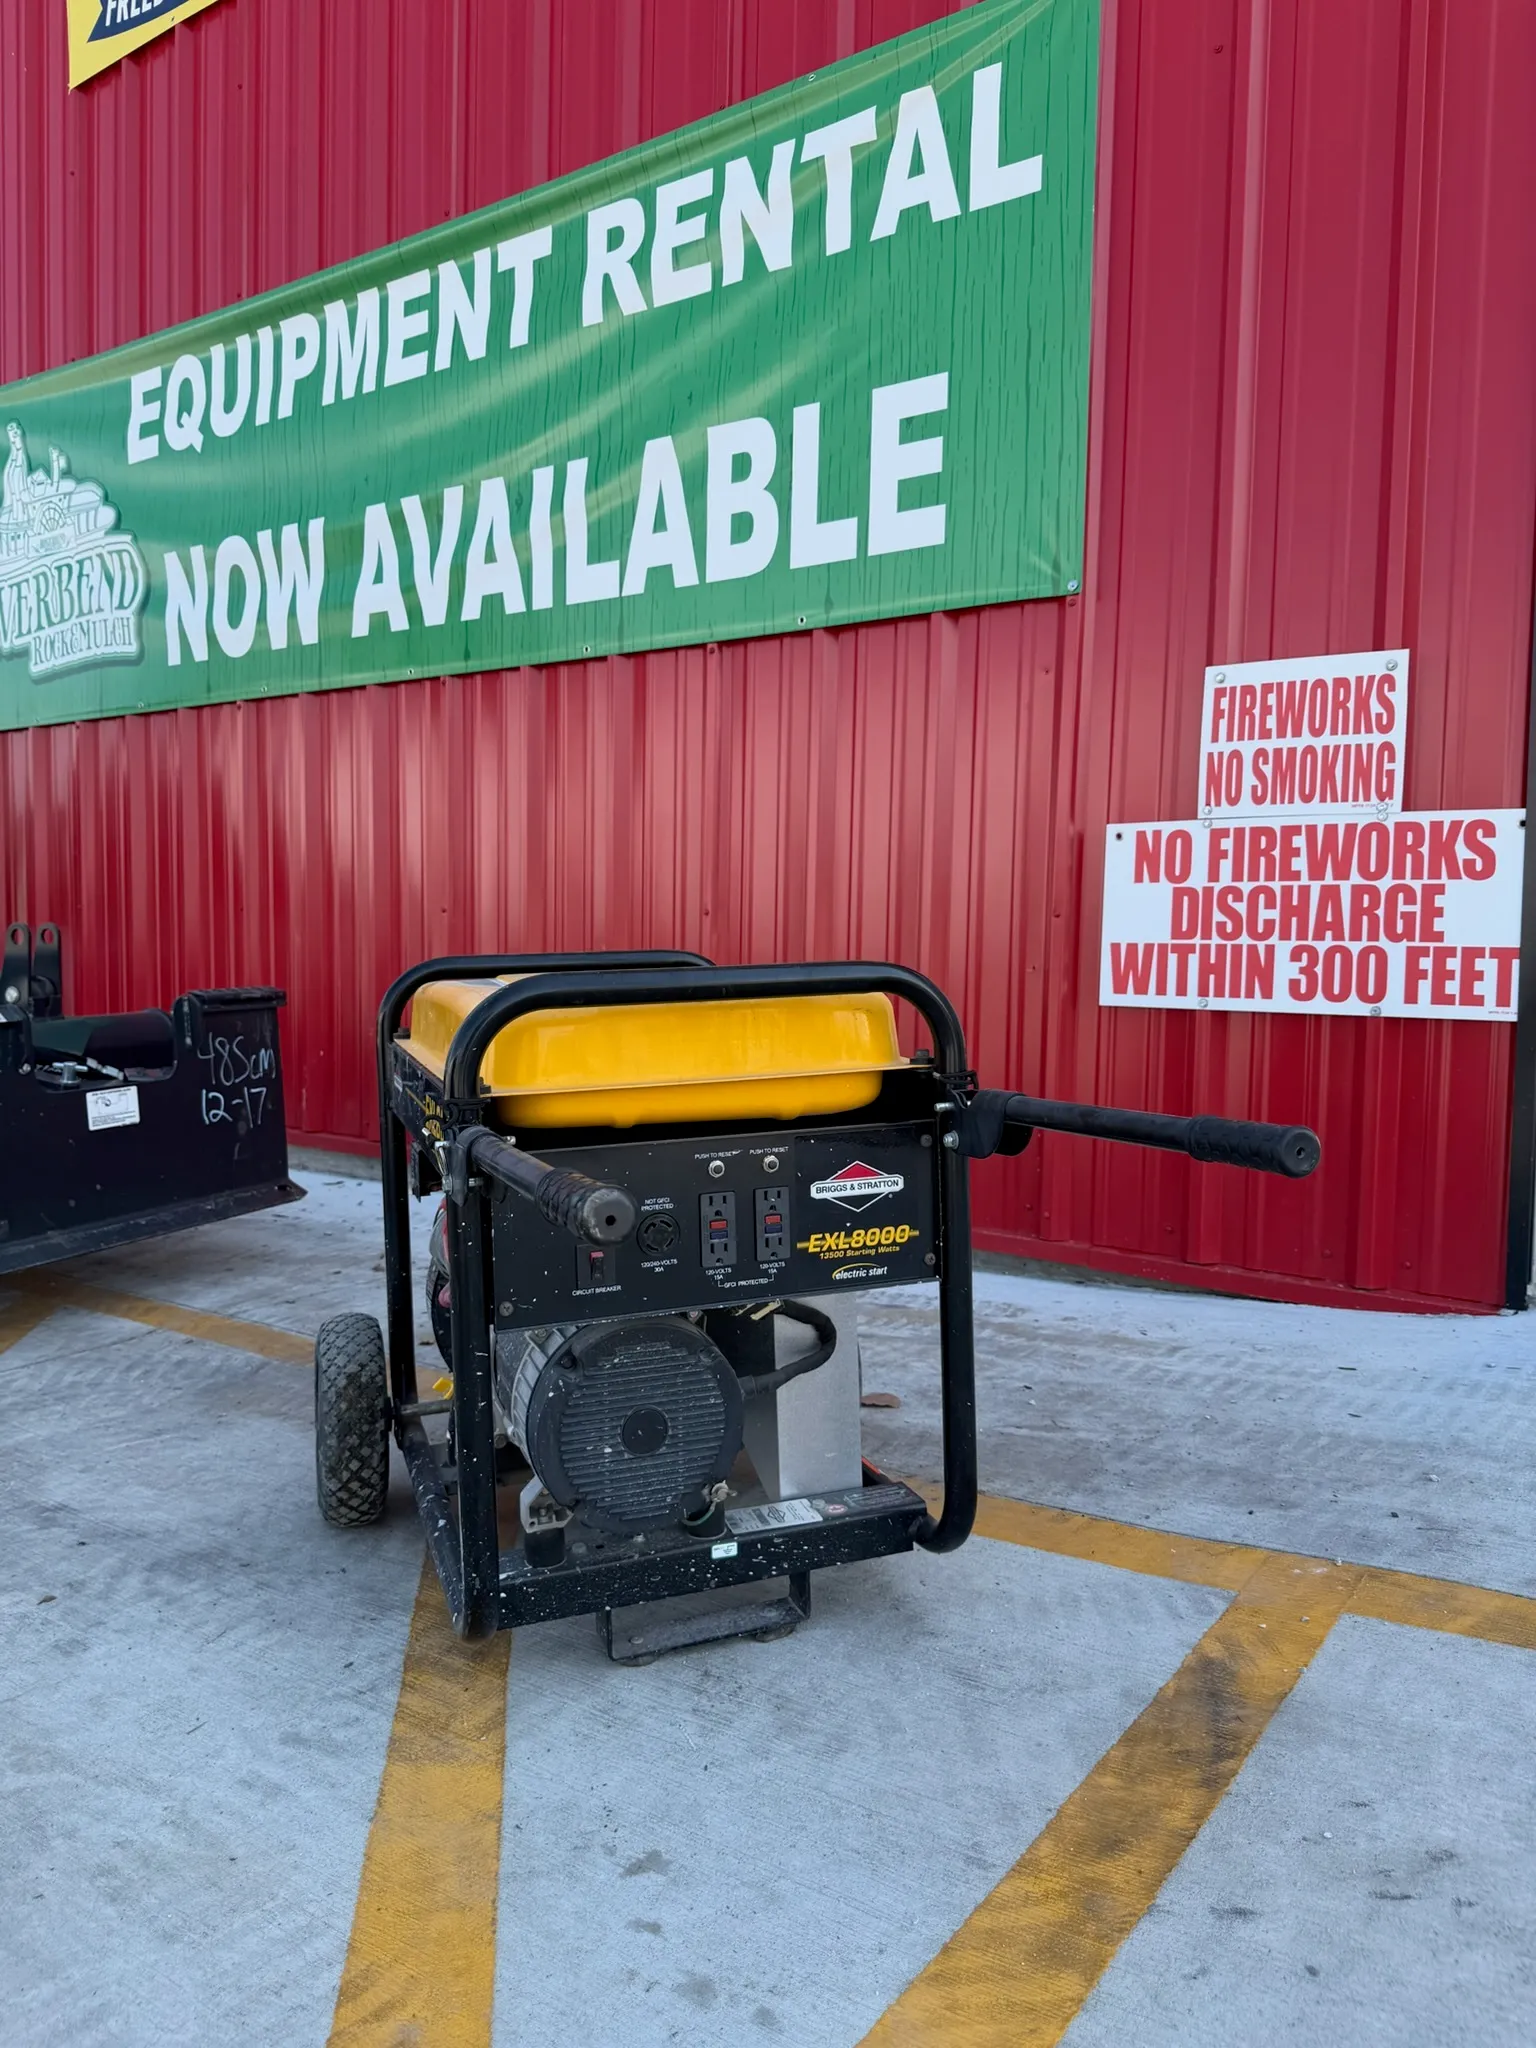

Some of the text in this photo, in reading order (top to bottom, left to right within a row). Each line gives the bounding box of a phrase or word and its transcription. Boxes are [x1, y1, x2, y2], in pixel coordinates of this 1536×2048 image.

[127, 62, 1042, 464] EQUIPMENT RENTAL
[164, 372, 948, 666] NOW AVAILABLE
[1211, 674, 1396, 743] FIREWORKS
[1206, 741, 1396, 807] NO SMOKING
[1134, 819, 1497, 884] NO FIREWORKS
[1170, 884, 1446, 943] DISCHARGE
[1110, 942, 1520, 1008] WITHIN 300 FEET
[202, 1086, 267, 1128] 12-17
[815, 1184, 847, 1194] BRIGGS
[857, 1179, 899, 1190] STRATTON
[641, 1203, 674, 1211] PROTECTED
[808, 1224, 910, 1253] EXL8000
[820, 1245, 900, 1260] 13500 Starting Watts
[705, 1267, 732, 1275] 120-VOLTS
[760, 1261, 785, 1270] 120-VOLTS
[835, 1266, 888, 1280] electric start
[572, 1285, 621, 1296] CIRCUIT BREAKER
[738, 1278, 769, 1287] PROTECTED
